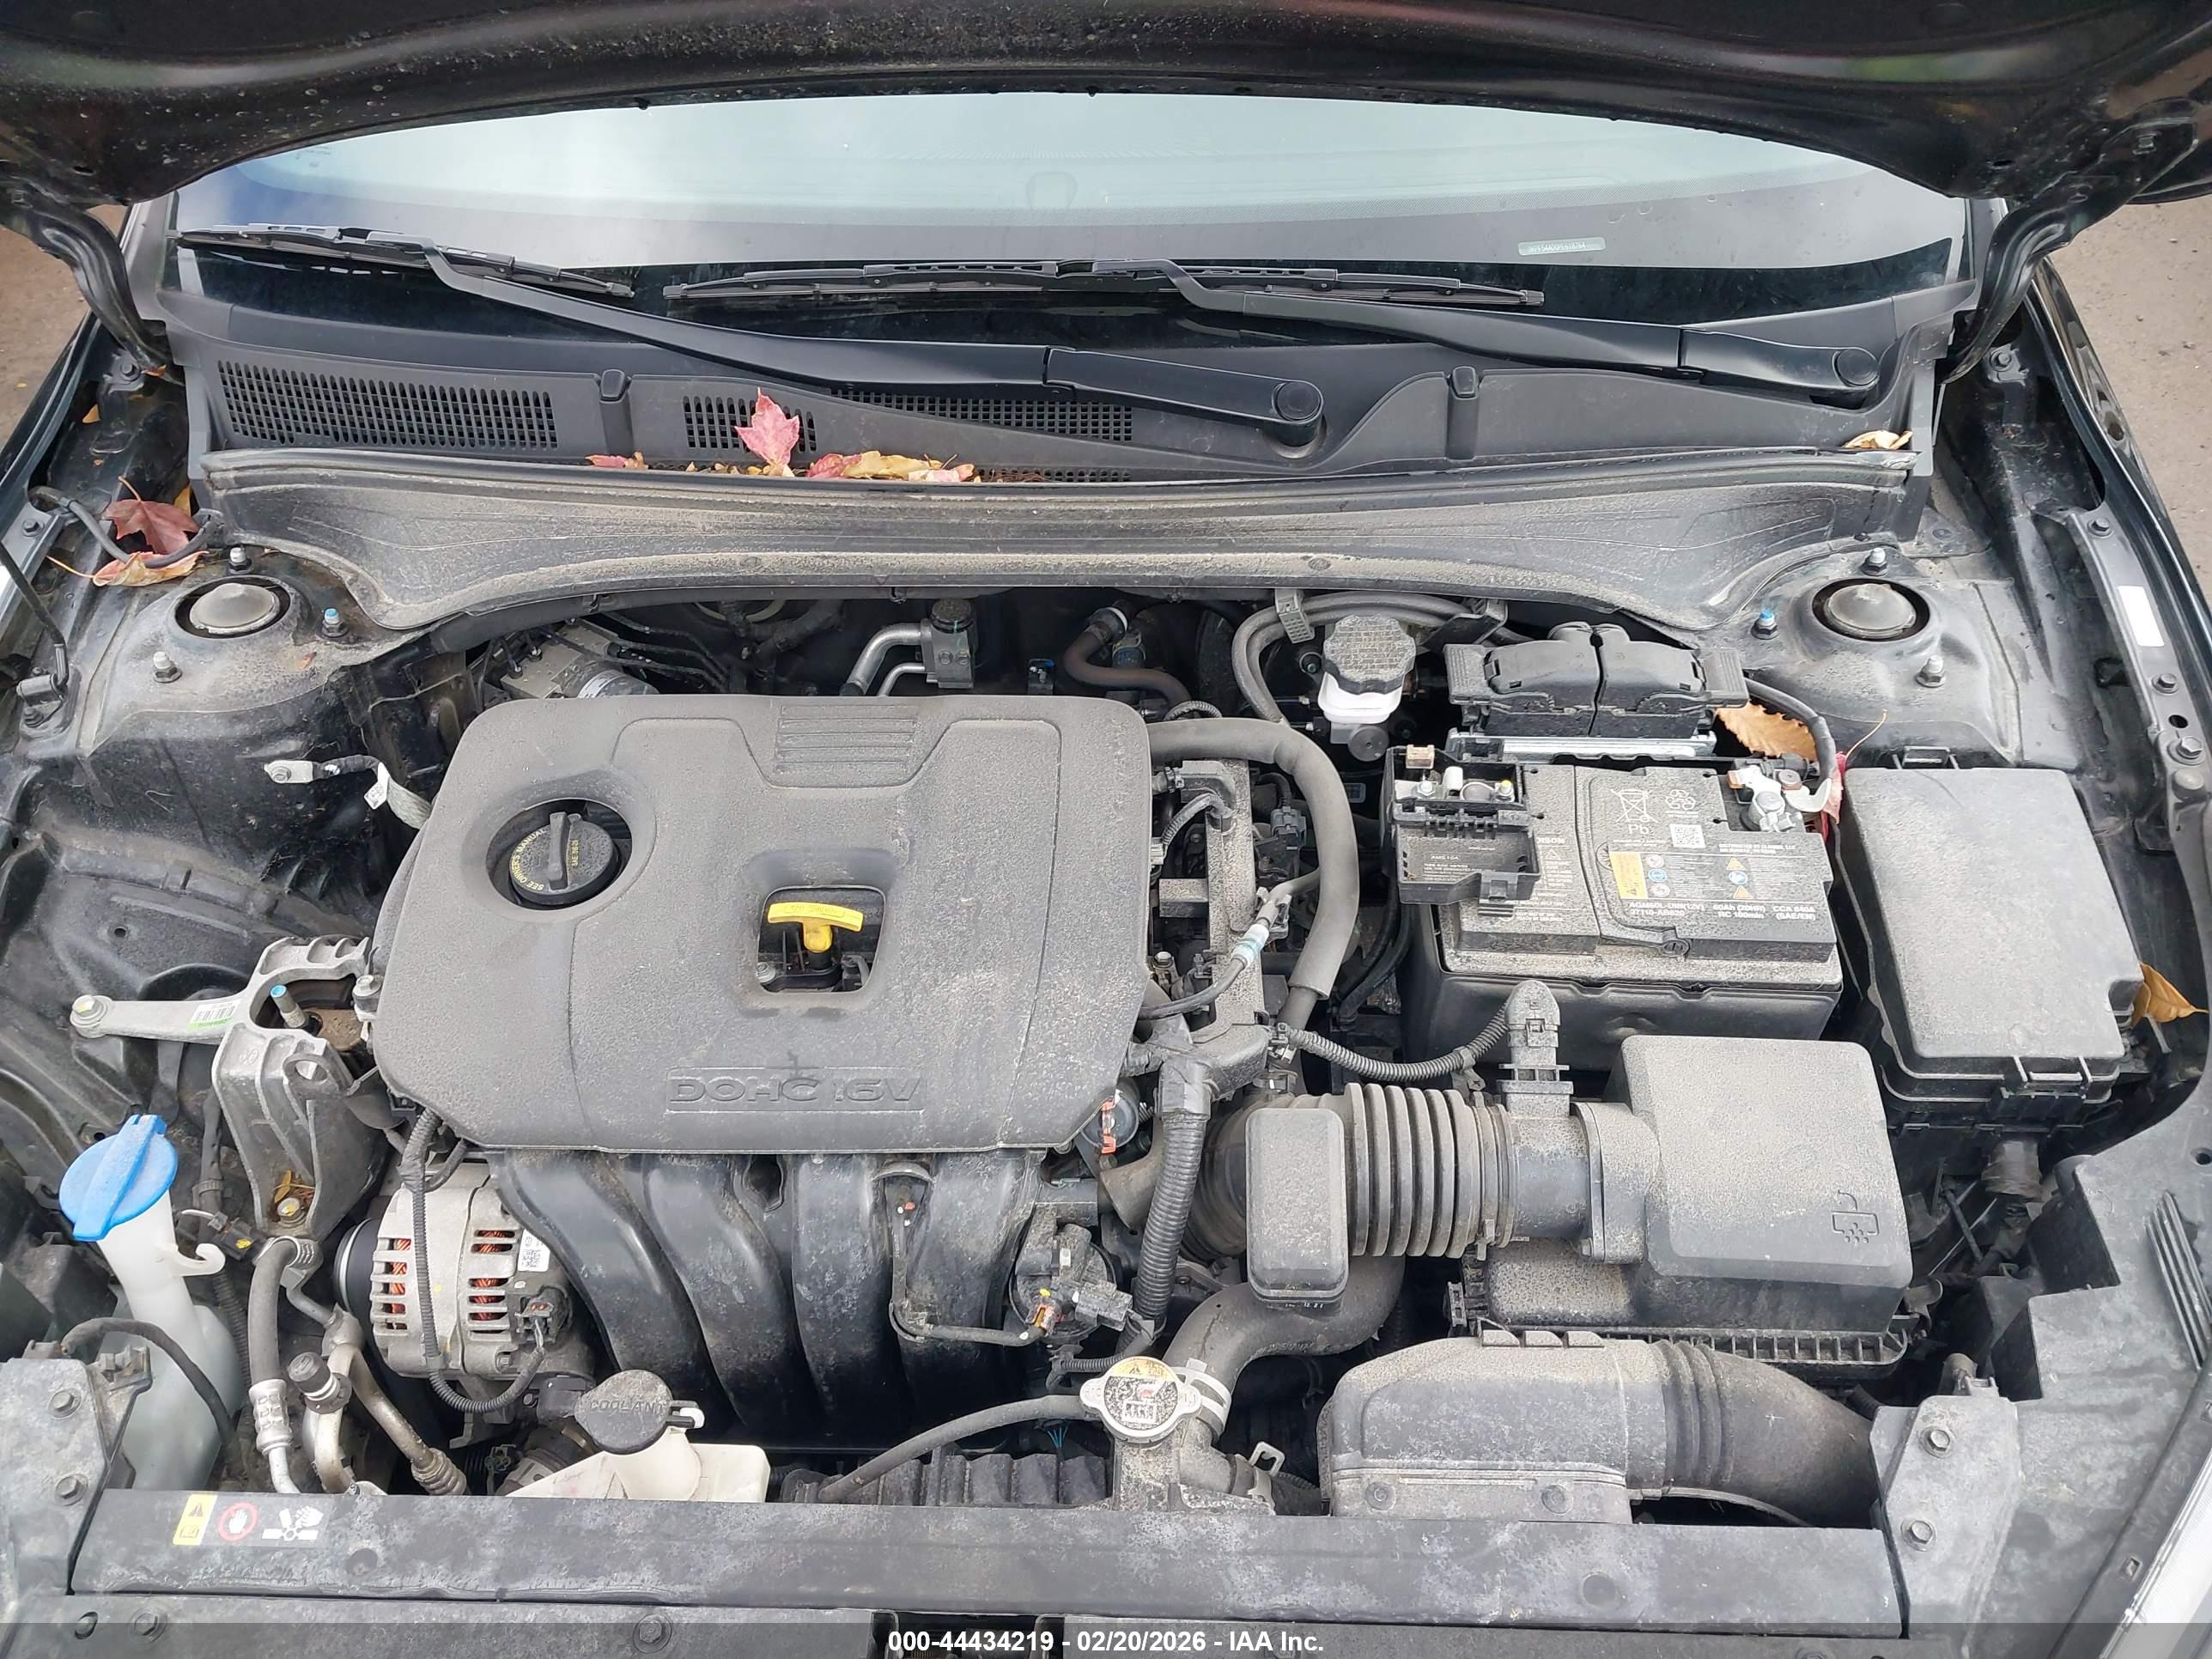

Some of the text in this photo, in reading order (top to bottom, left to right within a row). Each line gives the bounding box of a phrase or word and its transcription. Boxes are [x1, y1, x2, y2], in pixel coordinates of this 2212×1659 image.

[1628, 824, 1649, 834] Pb
[511, 828, 548, 890] SEE OWNER'S MANUAL
[670, 1076, 921, 1102] DOHC 16V
[590, 1400, 664, 1415] COOLANT
